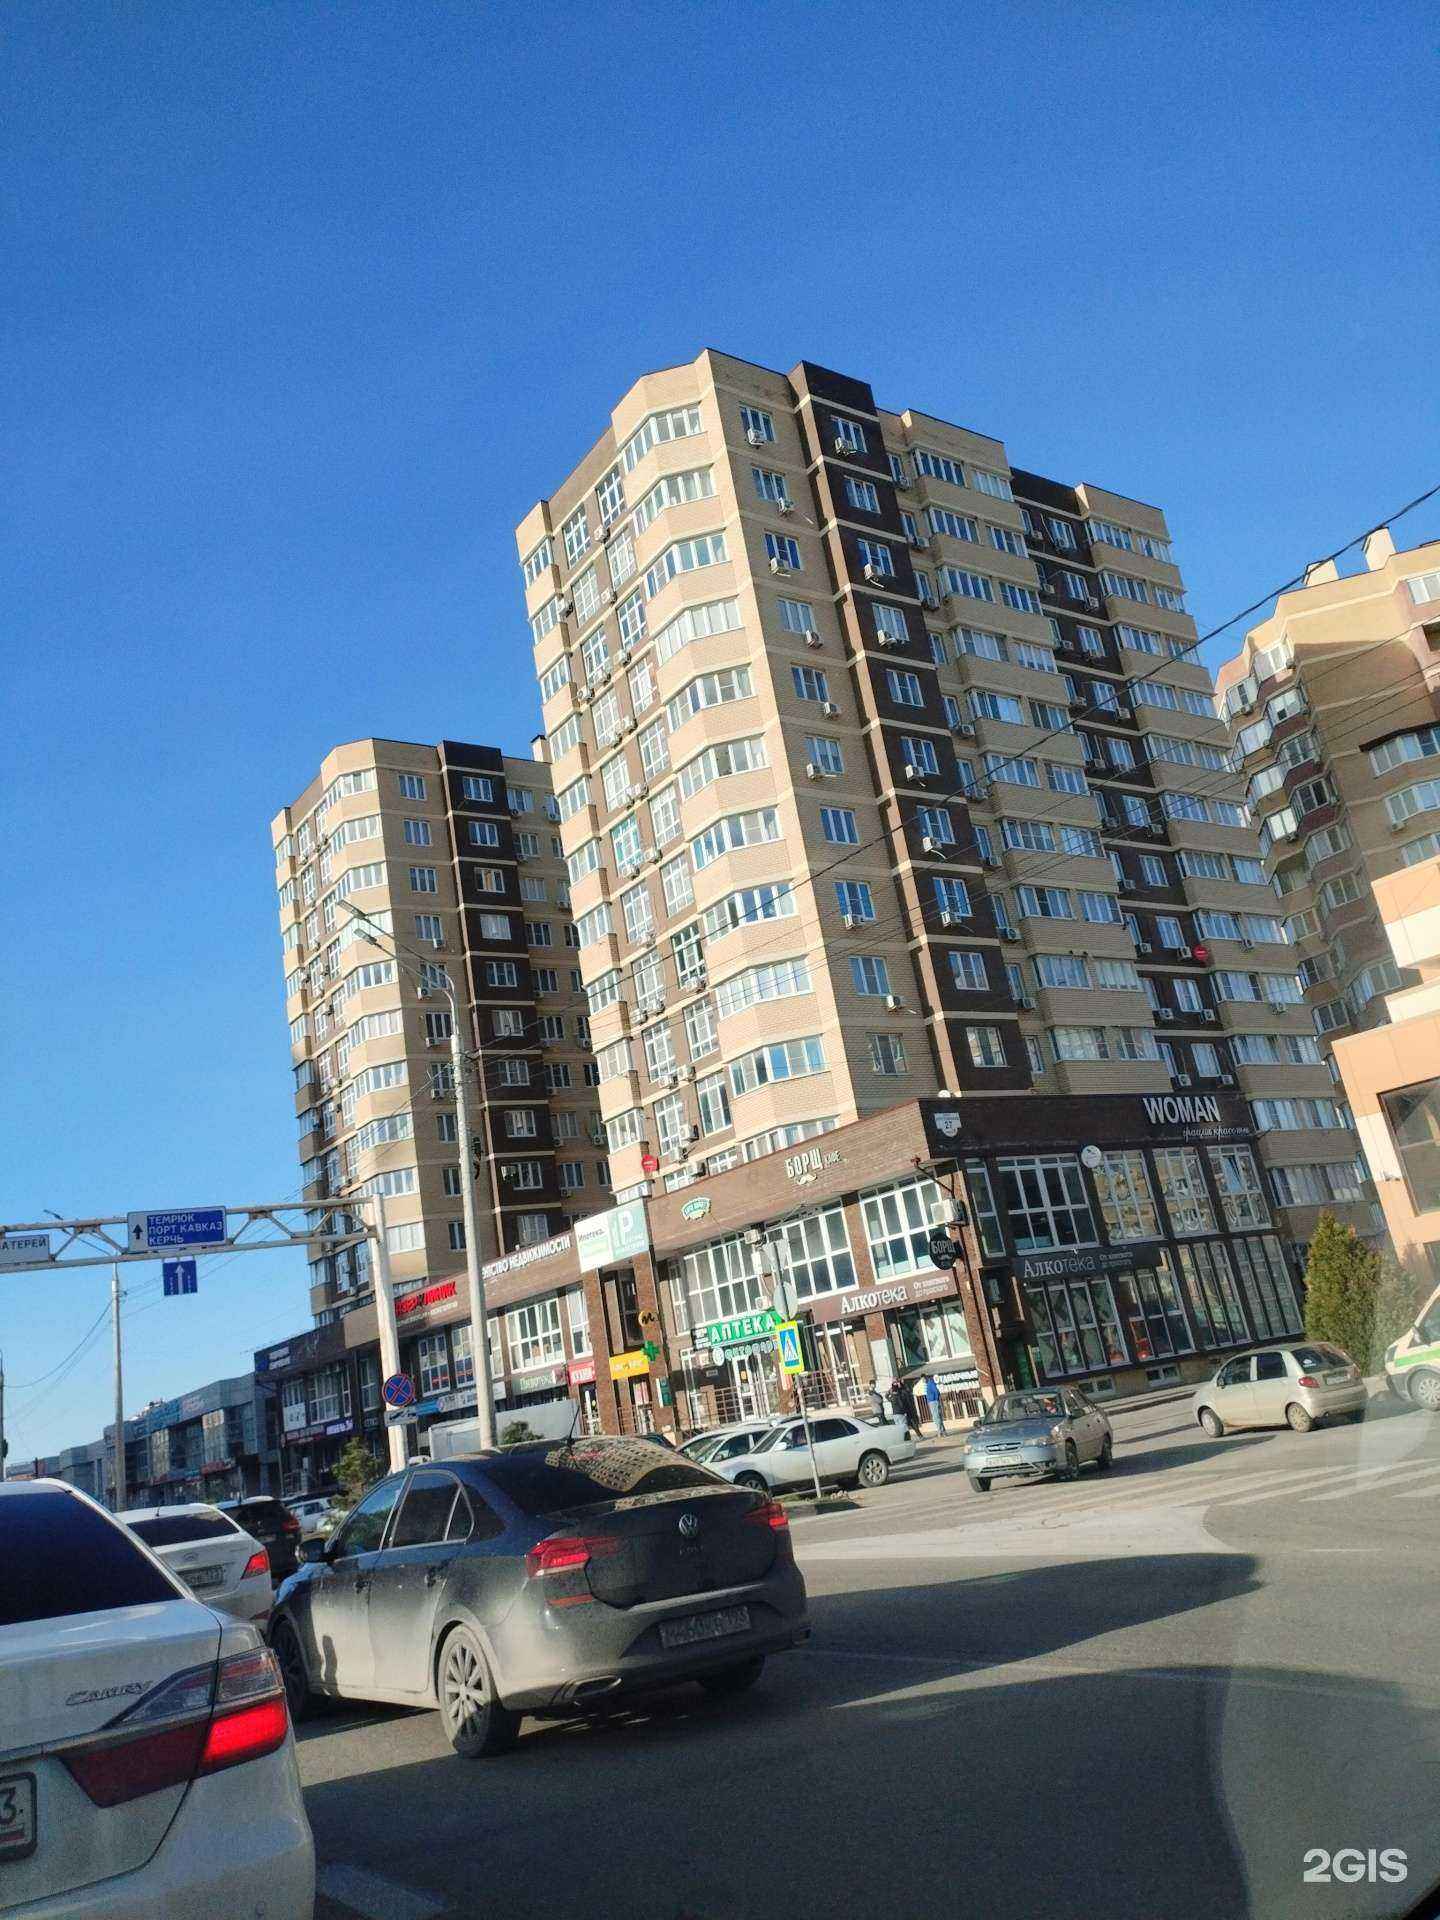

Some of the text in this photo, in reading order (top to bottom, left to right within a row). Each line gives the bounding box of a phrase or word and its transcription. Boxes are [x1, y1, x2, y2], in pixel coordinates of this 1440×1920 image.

[1142, 1096, 1221, 1124] WOMAN
[785, 1148, 824, 1178] БОРЩ
[148, 1213, 195, 1225] ТЕМРЮК
[148, 1221, 223, 1235] ПОРТ КАВКАЗ
[149, 1236, 184, 1246] КЕРЧЬ
[509, 1234, 571, 1269] НЕДВИЖИМОСТИ
[1024, 1255, 1097, 1278] Алкотека
[840, 1285, 908, 1314] Алкотека
[711, 1313, 775, 1344] АПТЕКА
